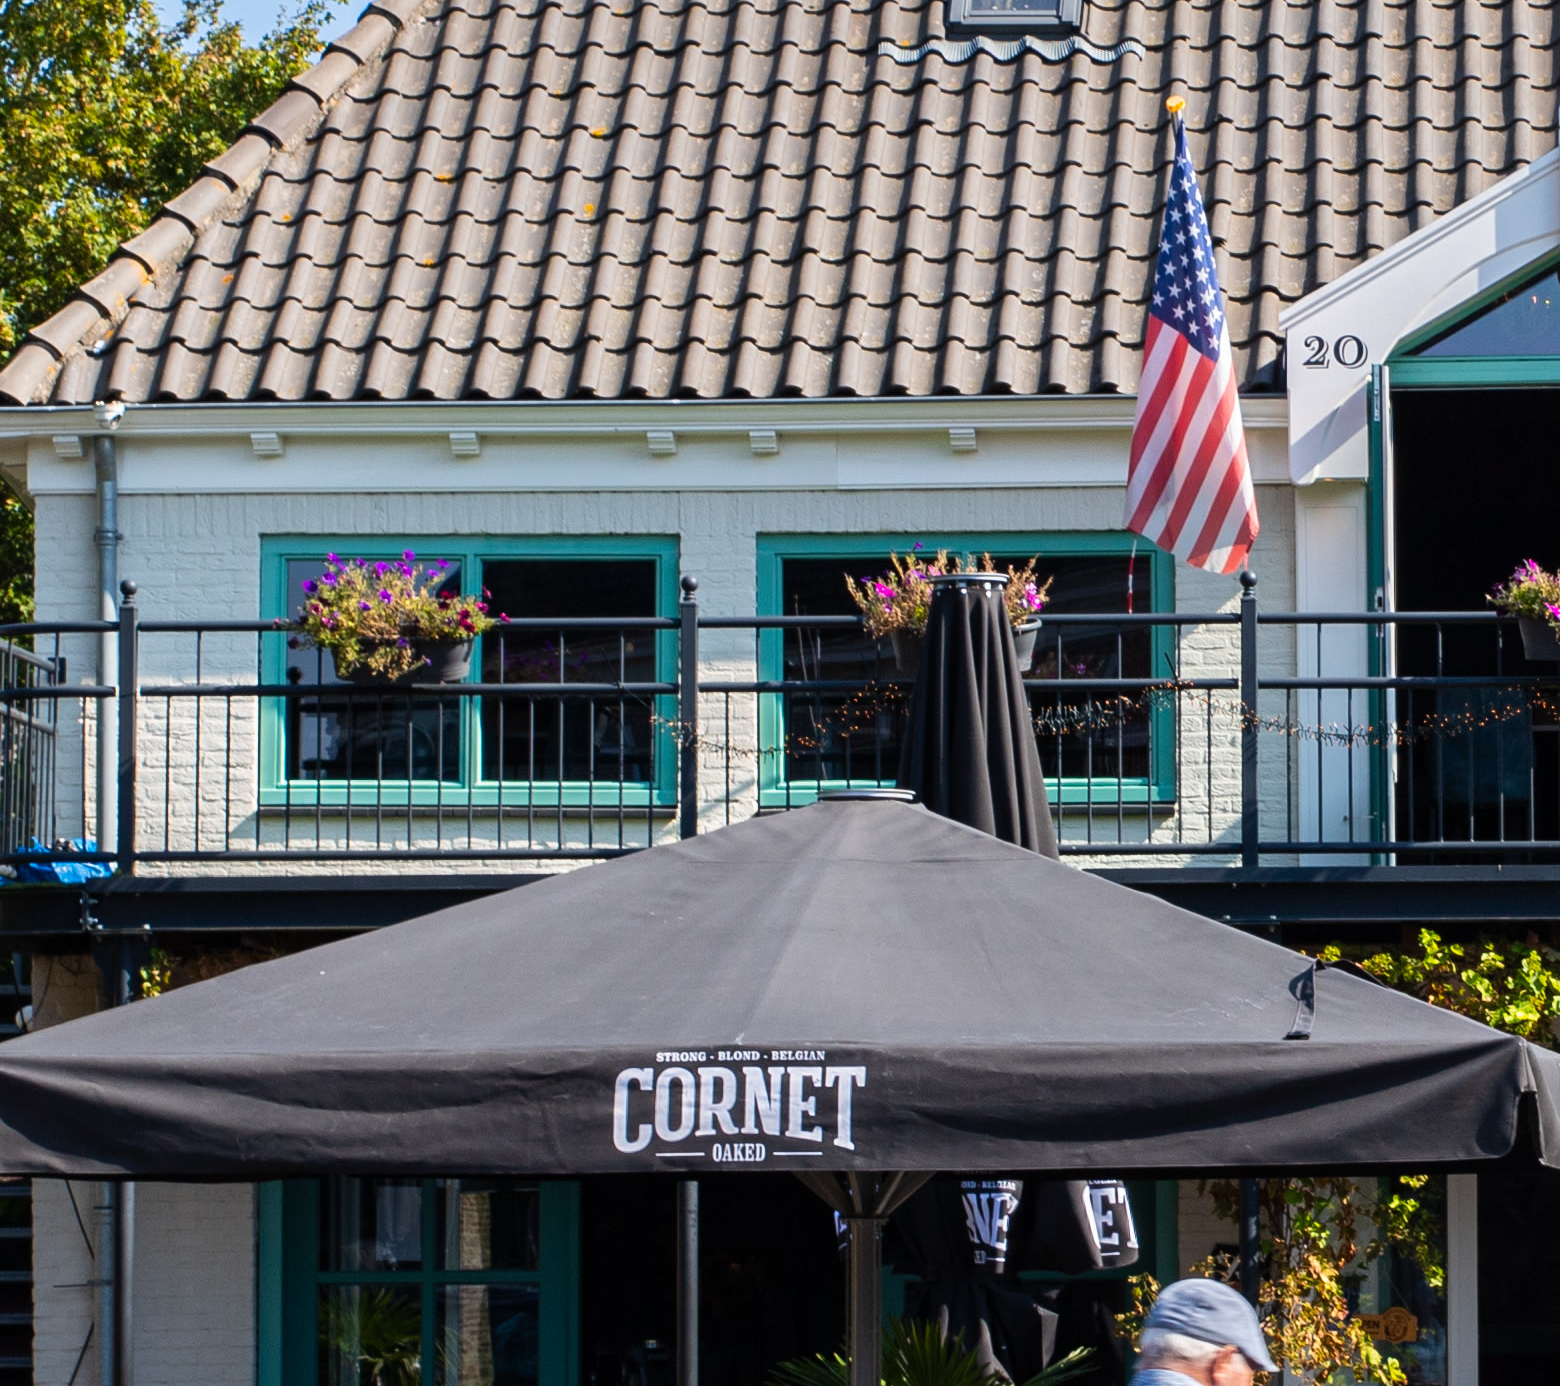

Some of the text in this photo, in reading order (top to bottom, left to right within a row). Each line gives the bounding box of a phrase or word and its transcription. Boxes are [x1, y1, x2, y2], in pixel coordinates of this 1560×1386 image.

[1303, 334, 1368, 369] 20
[656, 1050, 826, 1062] STRONG BLOND BELGIAN
[613, 1066, 867, 1154] CORNET
[712, 1143, 766, 1163] OAKED
